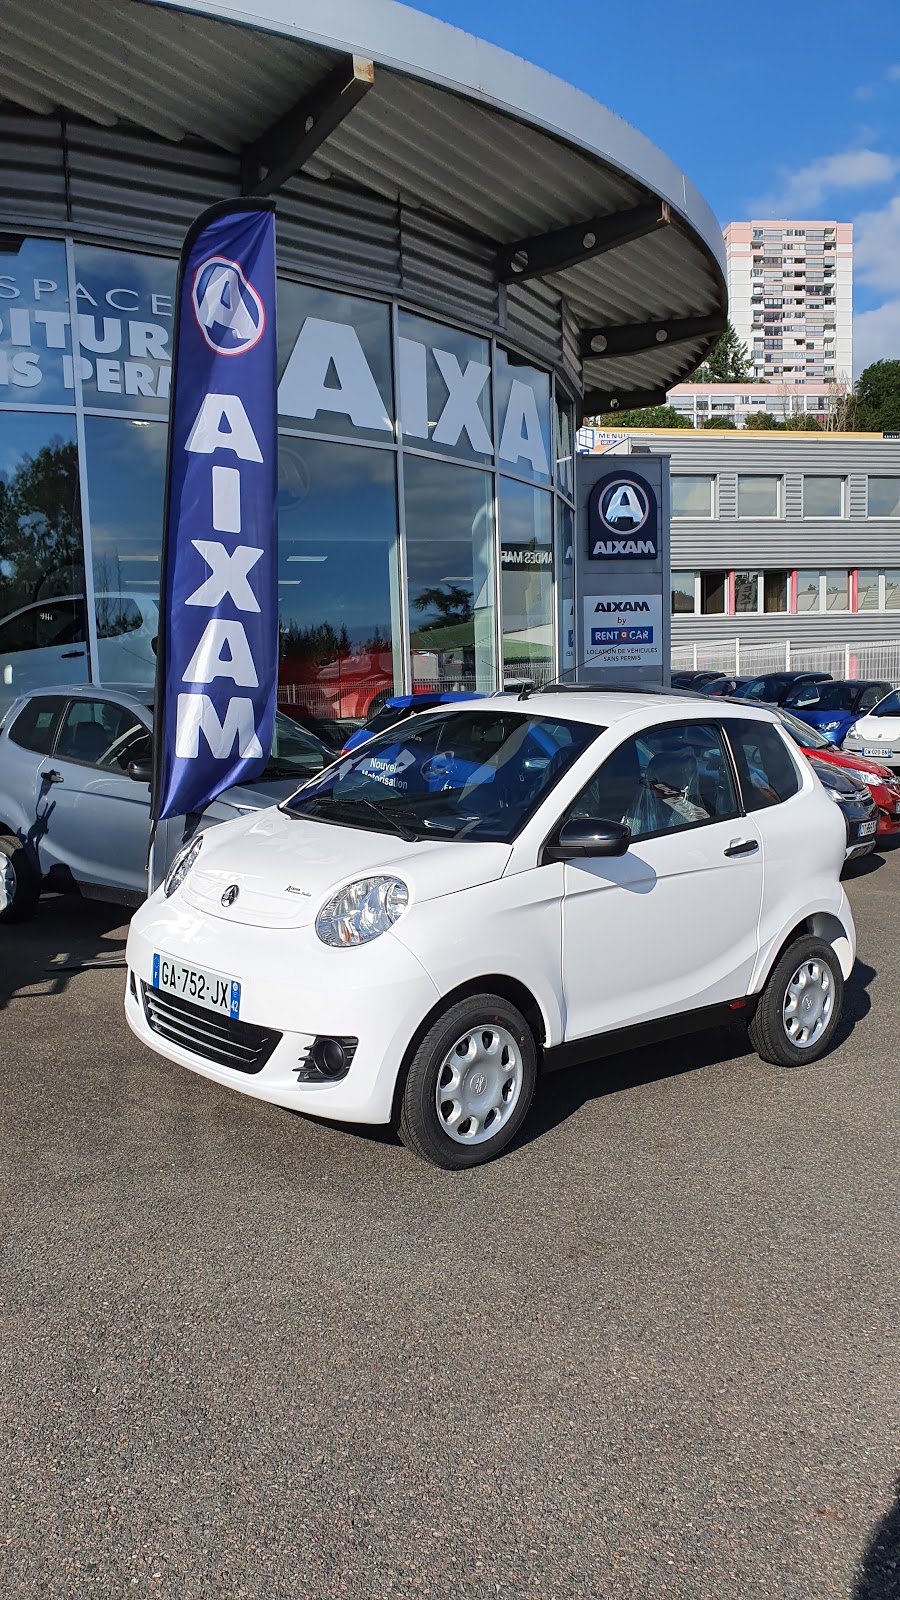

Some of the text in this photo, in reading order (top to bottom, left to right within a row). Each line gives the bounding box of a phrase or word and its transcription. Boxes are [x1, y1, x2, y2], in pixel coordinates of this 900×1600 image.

[0, 307, 171, 361] ITUR
[0, 351, 43, 388] S
[592, 541, 656, 555] AIXAM
[175, 393, 264, 759] AIXAM
[594, 601, 651, 613] AIXAM
[617, 616, 627, 626] by
[595, 631, 619, 641] RENT
[629, 630, 649, 640] CAR
[230, 1000, 239, 1013] 42
